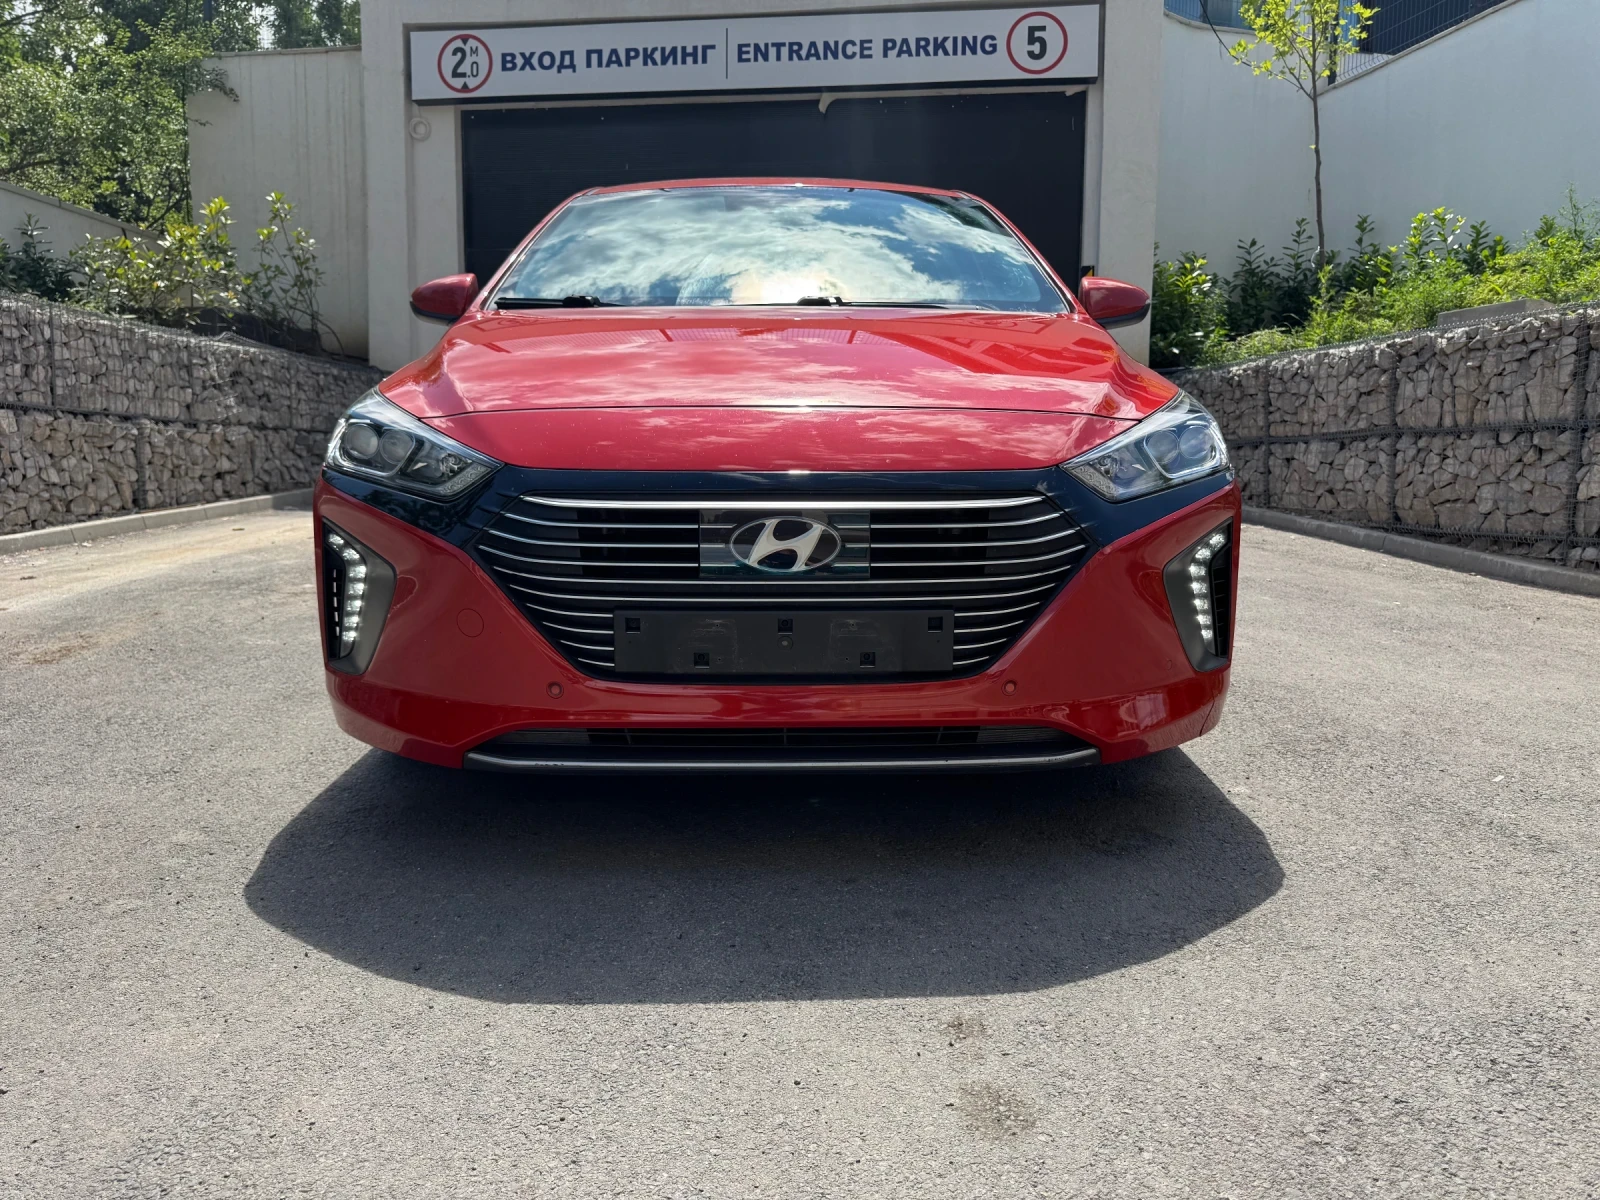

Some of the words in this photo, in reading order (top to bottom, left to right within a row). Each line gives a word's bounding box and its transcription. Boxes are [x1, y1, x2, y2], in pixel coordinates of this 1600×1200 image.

[736, 39, 873, 63] ENTRANCE
[882, 34, 998, 59] PARKING
[1026, 25, 1048, 61] 5
[500, 50, 577, 74] ВХОД
[585, 44, 716, 69] ПАРКИНГ
